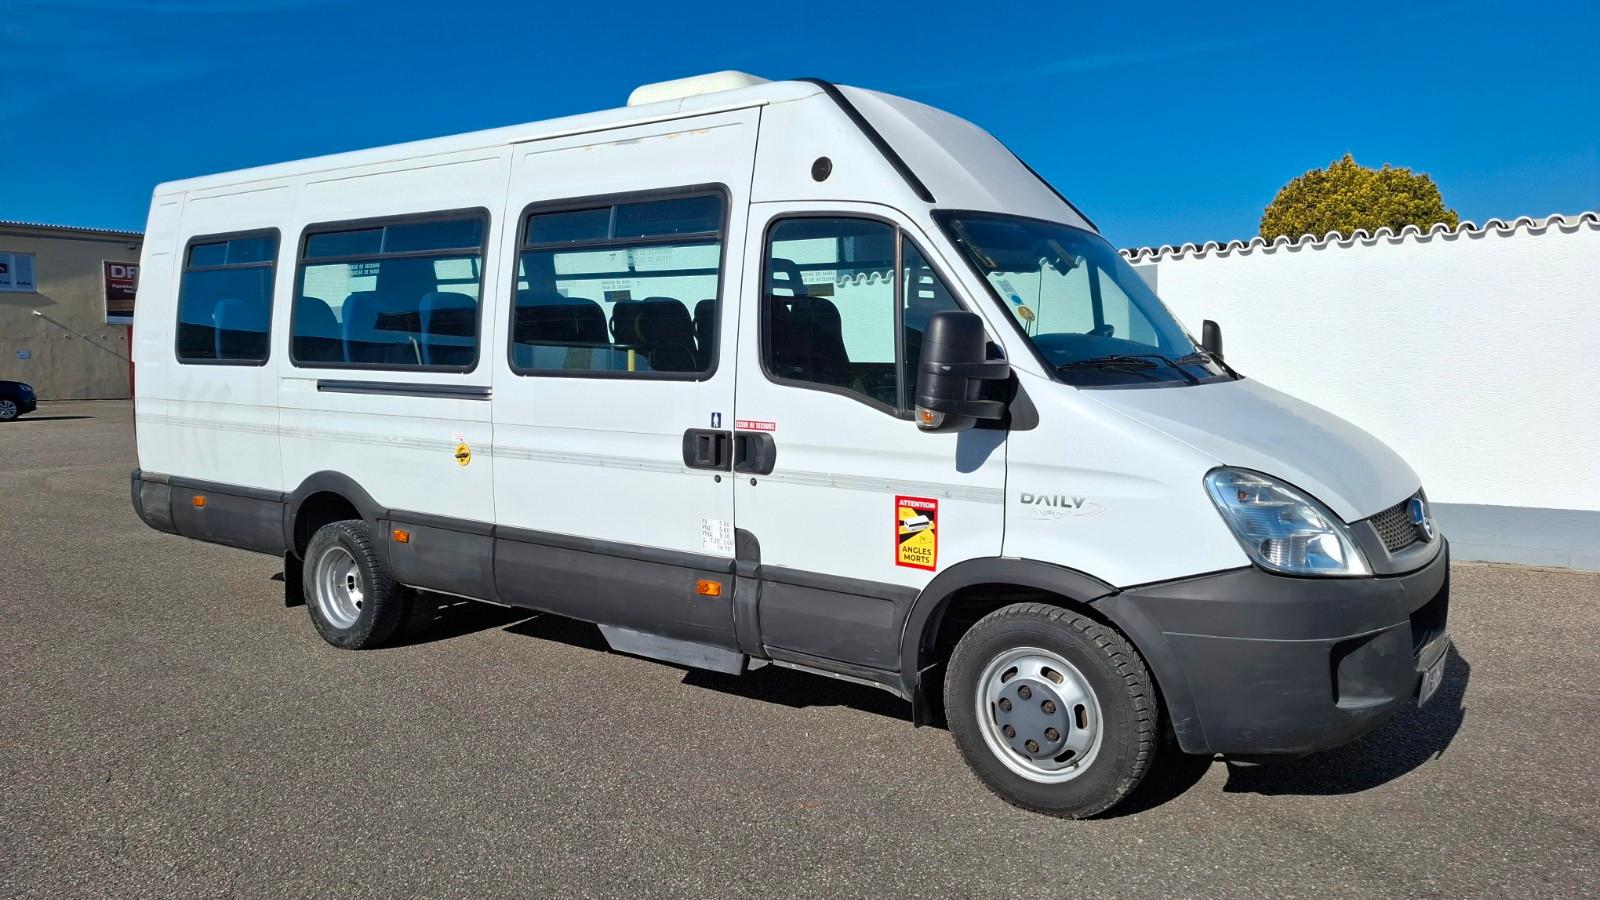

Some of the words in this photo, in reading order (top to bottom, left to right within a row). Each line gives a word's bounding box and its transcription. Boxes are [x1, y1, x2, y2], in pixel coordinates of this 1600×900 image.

[899, 500, 935, 509] ATTENTION
[1020, 493, 1086, 509] DAILY
[902, 546, 932, 556] ANGLES
[903, 554, 930, 564] MORTS
